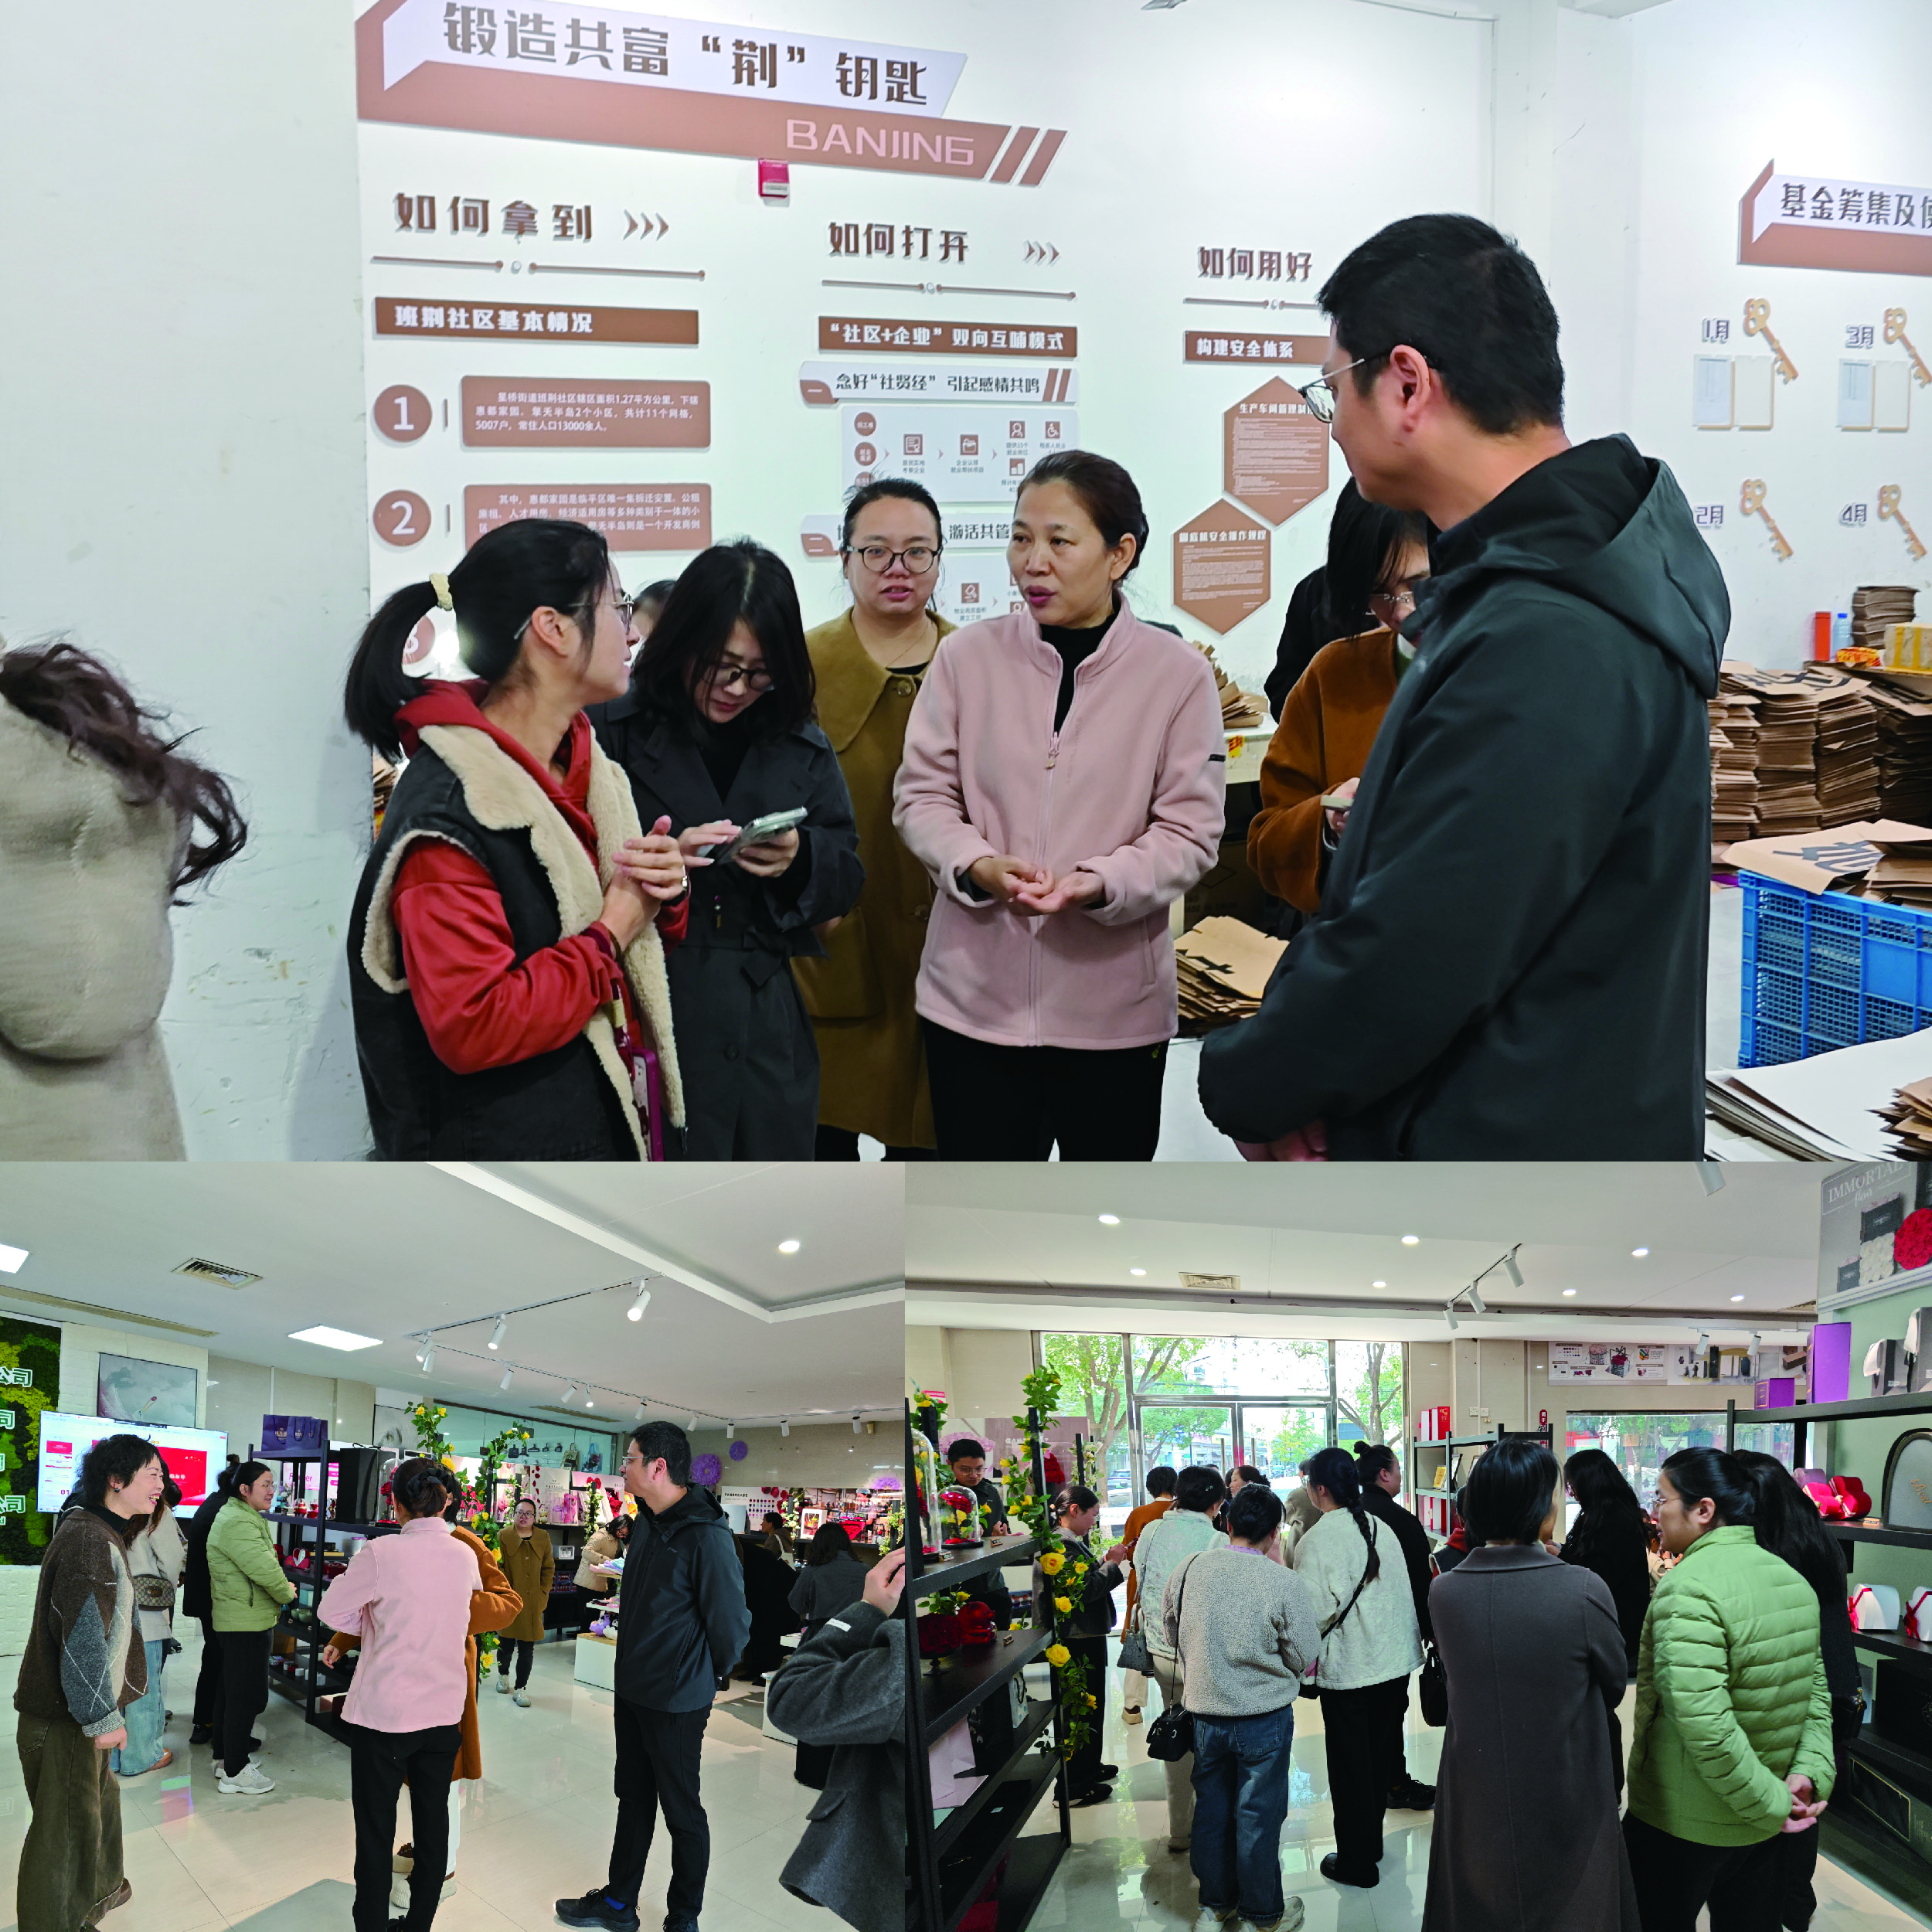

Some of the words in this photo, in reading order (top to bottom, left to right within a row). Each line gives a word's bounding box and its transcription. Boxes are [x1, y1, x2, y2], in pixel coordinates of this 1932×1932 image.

[786, 119, 975, 166] BANJING
[394, 192, 592, 240] 如何拿到
[828, 222, 968, 262] 如何打开
[1198, 247, 1312, 282] 如何用好
[394, 305, 594, 334] 班荆社区基本情况
[1702, 318, 1730, 342] 1月
[1196, 338, 1294, 359] 构建安全体系
[1845, 325, 1874, 347] 3月
[393, 396, 415, 430] 1
[392, 500, 415, 535] 2
[1696, 505, 1723, 525] 2月
[1841, 504, 1867, 522] 4月
